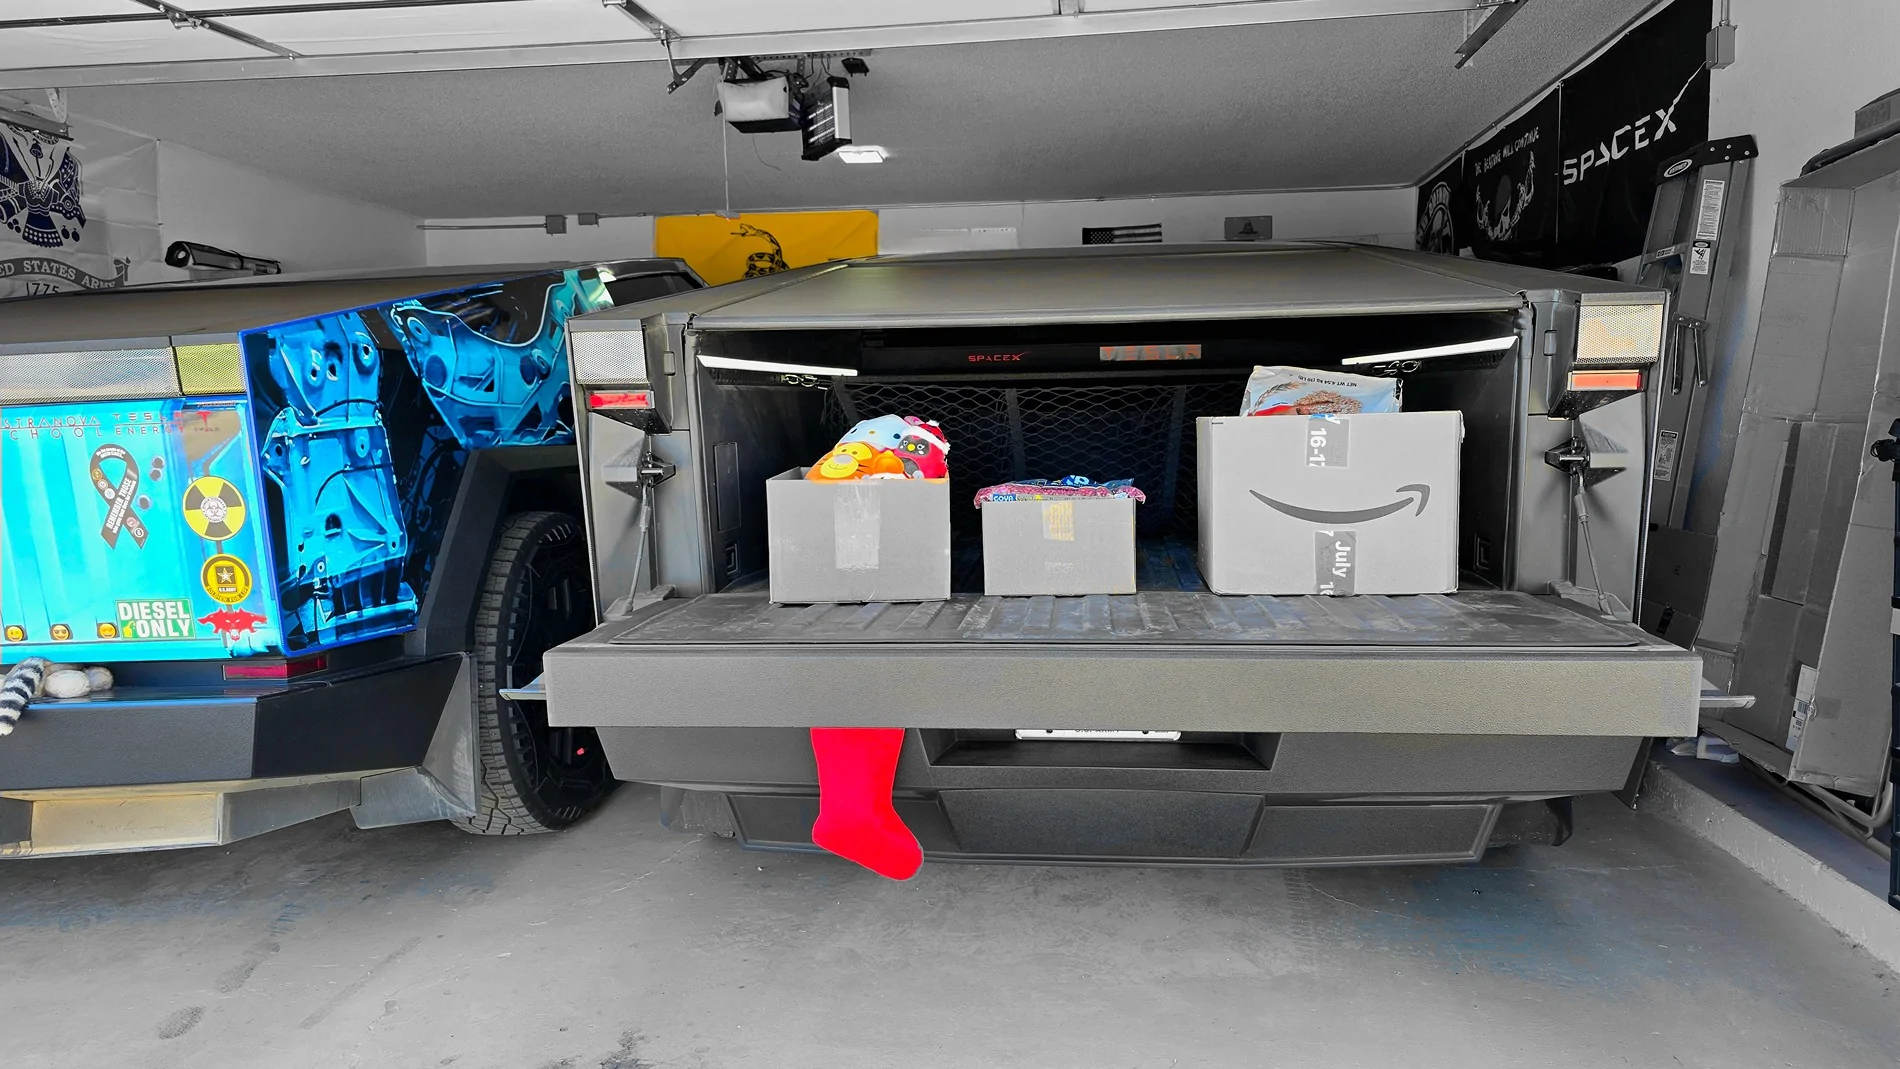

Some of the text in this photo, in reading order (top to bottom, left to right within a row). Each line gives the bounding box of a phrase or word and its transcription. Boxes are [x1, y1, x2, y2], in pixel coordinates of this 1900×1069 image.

[1502, 143, 1514, 158] WILL
[1514, 126, 1540, 152] CONTINUE
[1563, 99, 1683, 185] SPACEX
[23, 260, 76, 280] STATES
[968, 353, 1024, 362] SPACEX
[1103, 345, 1200, 360] TESLA
[10, 427, 102, 440] CHOOL
[105, 477, 132, 530] REMEMBER THOSE
[1332, 540, 1351, 578] July
[118, 601, 190, 621] DIESEL
[136, 619, 191, 638] ONLY
